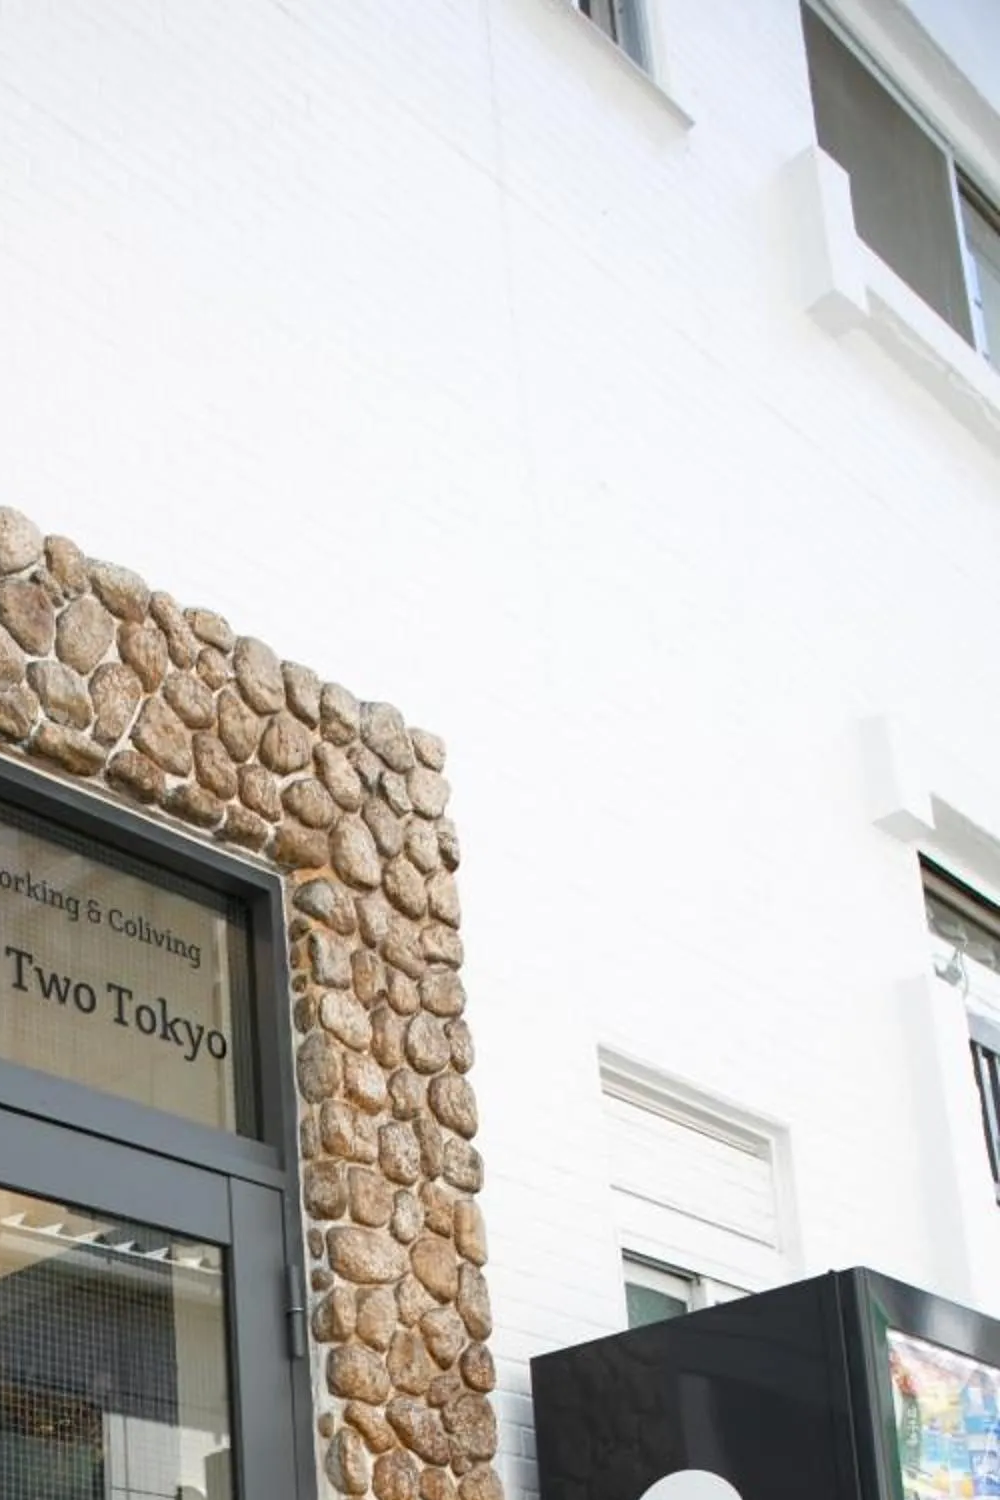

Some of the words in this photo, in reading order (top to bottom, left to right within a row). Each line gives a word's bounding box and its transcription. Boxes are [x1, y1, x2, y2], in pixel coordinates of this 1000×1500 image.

[109, 909, 202, 968] Coliving
[5, 945, 98, 1015] Two
[106, 983, 228, 1062] Tokyo
